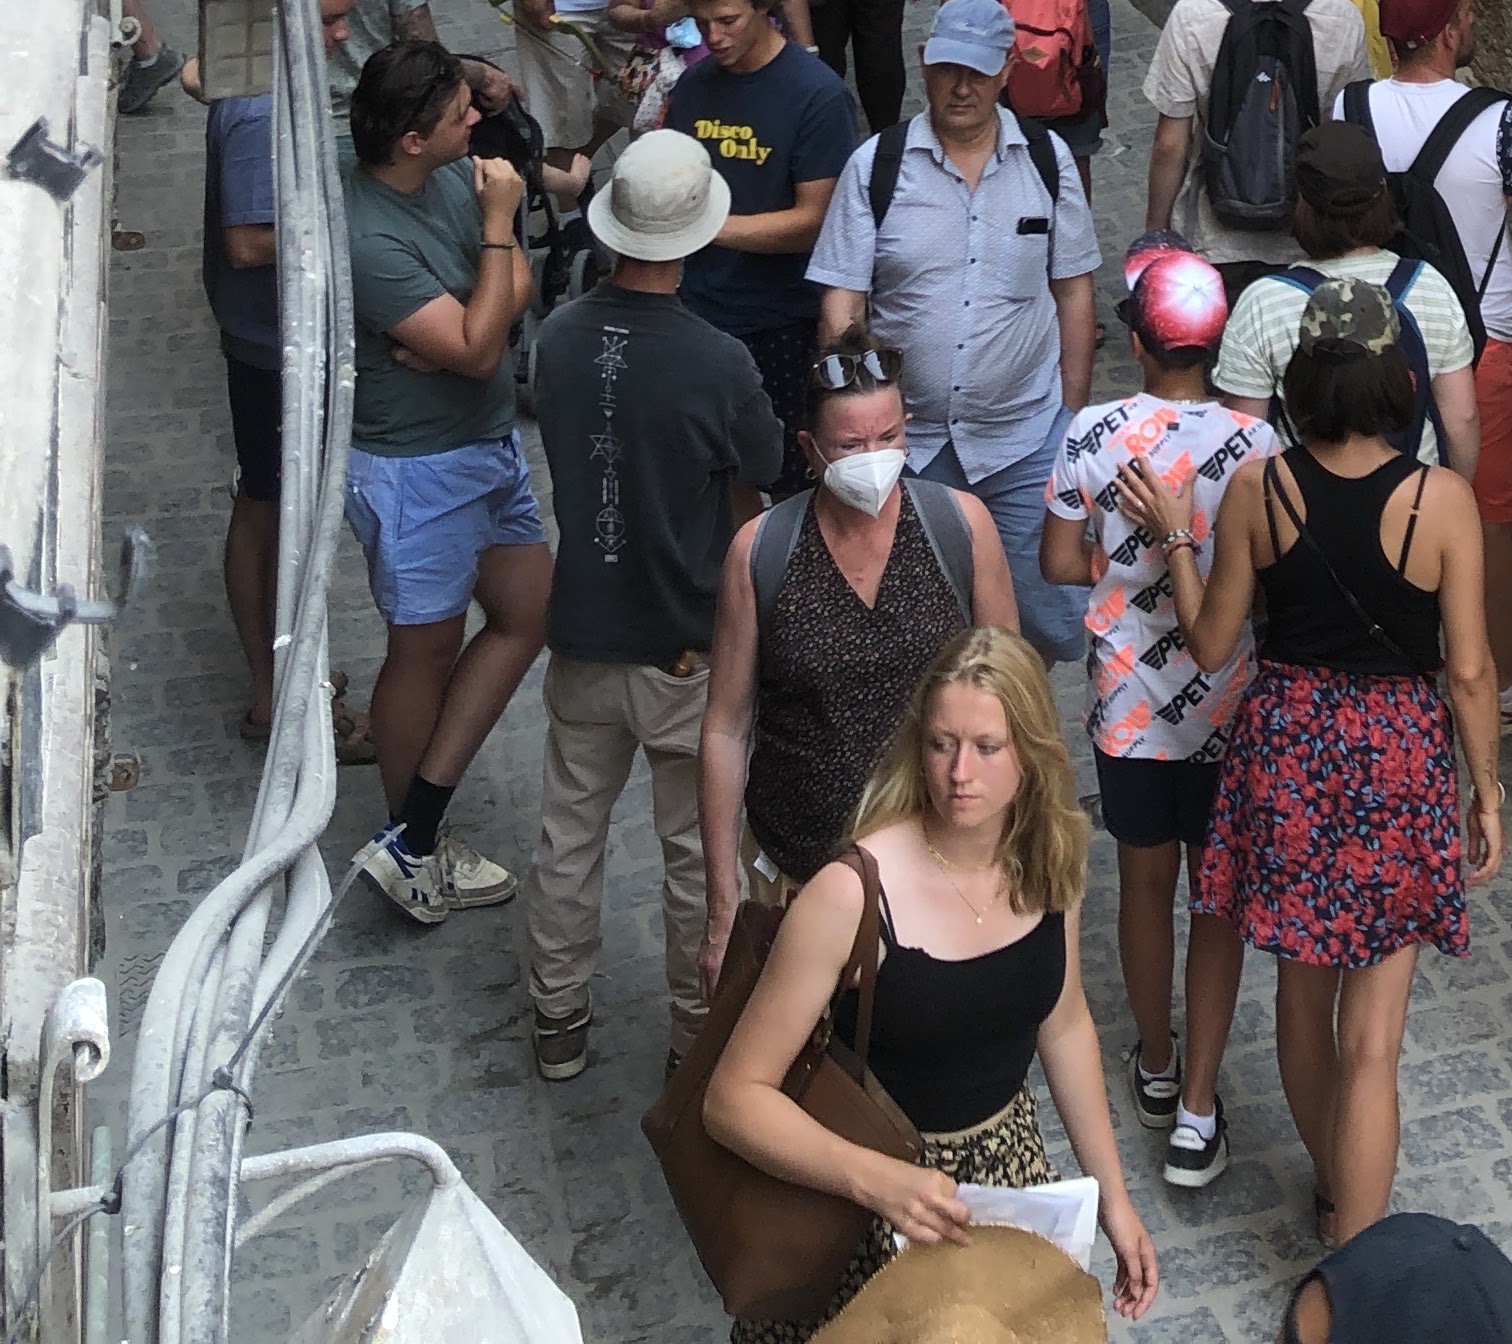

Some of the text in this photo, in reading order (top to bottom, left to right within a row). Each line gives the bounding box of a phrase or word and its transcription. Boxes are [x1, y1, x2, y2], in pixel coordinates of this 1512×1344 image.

[693, 119, 754, 140] Disco
[719, 137, 773, 166] Only
[1171, 671, 1212, 722] PET
